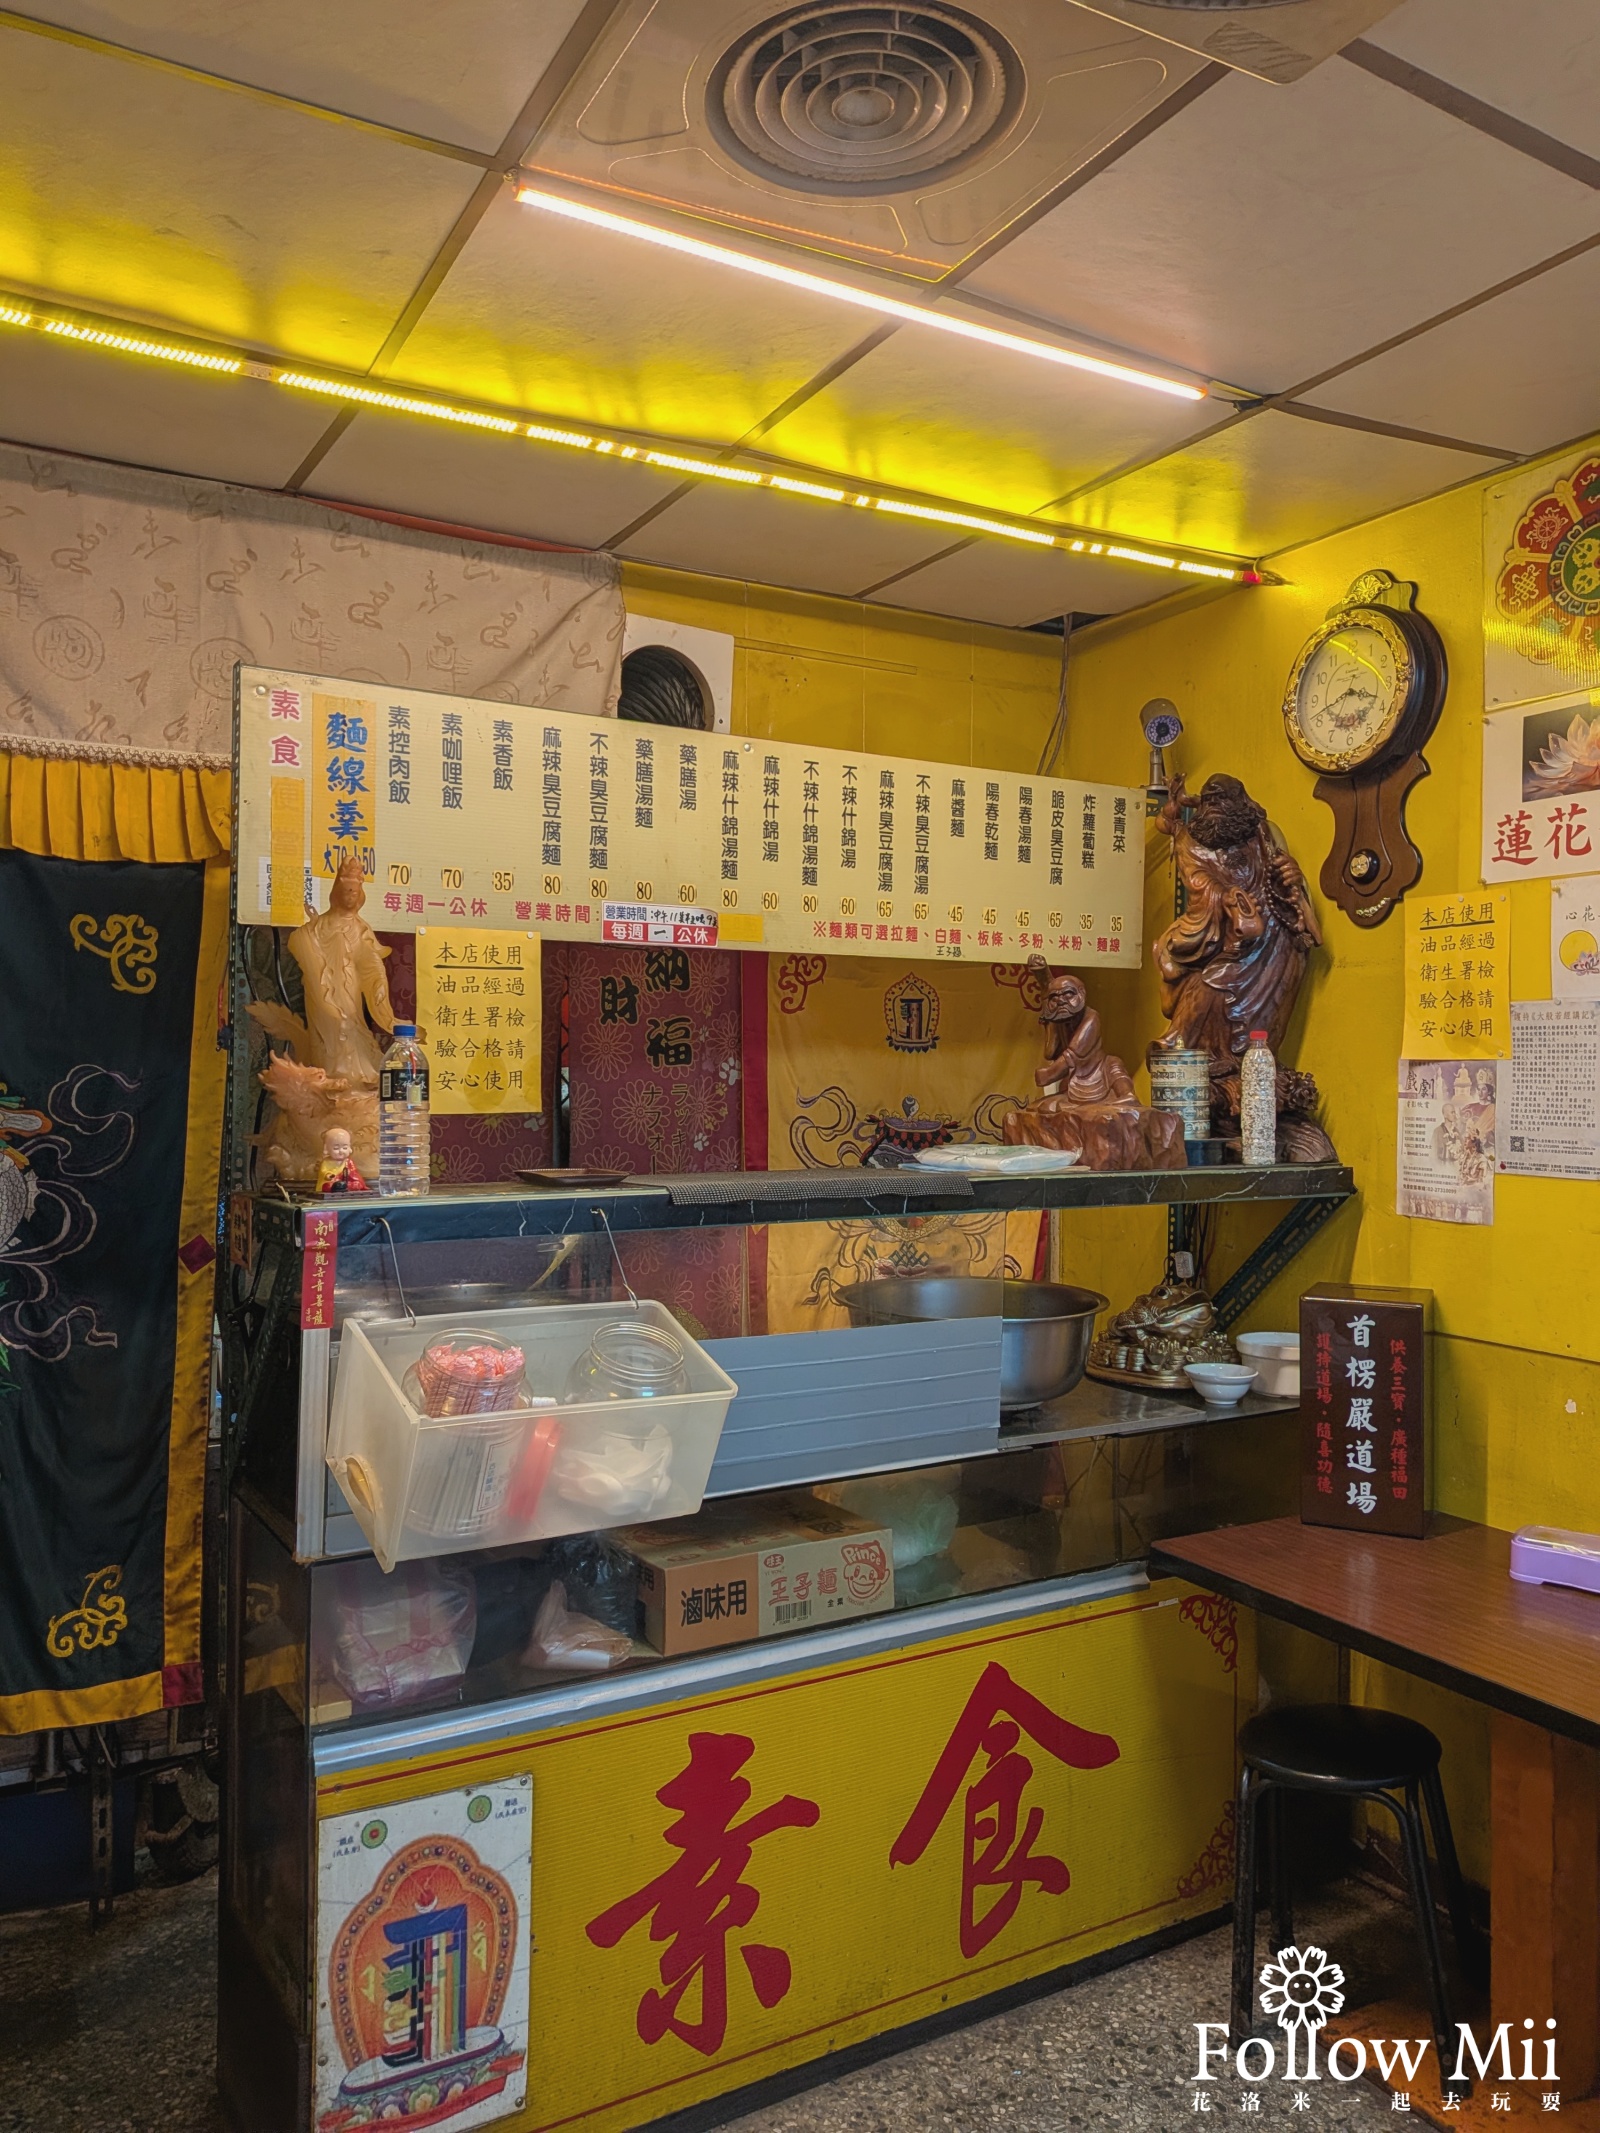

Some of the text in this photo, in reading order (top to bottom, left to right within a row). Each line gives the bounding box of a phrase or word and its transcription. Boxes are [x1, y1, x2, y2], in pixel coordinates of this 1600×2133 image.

[1328, 654, 1338, 667] 11
[1379, 654, 1388, 668] 2
[1316, 672, 1327, 686] 10
[1311, 695, 1319, 708] 9
[1378, 699, 1385, 713] 4
[271, 689, 300, 767] 素食
[1315, 714, 1324, 728] 8
[1364, 722, 1373, 736] 5
[1327, 729, 1335, 743] 7
[1346, 731, 1354, 746] 6
[388, 706, 411, 804] 素控肉飯
[441, 713, 463, 810] 素咖哩飯
[492, 720, 514, 791] 素香飯
[326, 711, 370, 841] 麵線羹
[635, 738, 654, 829] 藥膳湯麵
[679, 744, 697, 811] 藥膳湯
[541, 726, 562, 866] 麻辣臭豆腐麵
[589, 732, 609, 870] 不辣臭豆腐麵
[721, 750, 740, 881] 麻辣什錦湯麵
[762, 755, 780, 862] 麻辣什錦湯
[840, 765, 858, 869] 不辣什錦湯
[950, 778, 966, 838] 麻醬麵
[801, 760, 819, 887] 不辣什錦湯麵
[878, 769, 895, 892] 麻辣臭豆腐湯
[984, 782, 1000, 861] 陽春乾麵
[1018, 786, 1033, 864] 陽春湯麵
[1081, 794, 1096, 870] 炸蘿蔔糕
[1112, 797, 1126, 853] 燙青菜
[914, 774, 931, 895] 不辣臭豆腐湯
[1050, 790, 1065, 886] 脆皮臭豆腐
[1491, 803, 1598, 866] 蓮花
[390, 865, 410, 885] 70
[443, 868, 462, 888] 70
[494, 872, 512, 891] 35
[544, 876, 561, 895] 80
[591, 878, 608, 898] 80
[636, 881, 652, 900] 80
[680, 885, 695, 903] 60
[723, 890, 738, 907] 80
[383, 892, 488, 918] 每週一公休
[763, 892, 778, 910] 60
[803, 896, 817, 913] 80
[841, 898, 855, 915] 60
[879, 900, 892, 918] 65
[914, 903, 927, 920] 65
[950, 906, 963, 922] 45
[984, 908, 996, 925] 45
[1017, 911, 1030, 927] 45
[1050, 912, 1062, 928] 65
[1081, 914, 1092, 930] 35
[1111, 916, 1122, 932] 35
[1420, 902, 1494, 926] 本店使用
[1566, 905, 1600, 922] 心花
[436, 941, 521, 965] 本店使用
[1420, 931, 1495, 954] 油品經過
[1419, 960, 1495, 982] 衛生署檢
[436, 975, 525, 996] 油品經過
[601, 975, 639, 1025] 財
[645, 948, 692, 1067] 納福
[1419, 989, 1495, 1010] 驗合格請
[435, 1005, 526, 1028] 衛生署檢
[1419, 1018, 1494, 1038] 安心使用
[434, 1038, 526, 1060] 驗合格請
[435, 1070, 523, 1091] 安心使用
[1405, 1071, 1435, 1099] 戲劇
[1345, 1314, 1377, 1514] 首楞嚴道場
[765, 1555, 784, 1568] 味王
[844, 1546, 881, 1566] Prince
[768, 1567, 838, 1606] 王子麵
[681, 1580, 747, 1627] 滷味用
[585, 1661, 1120, 2056] 素食
